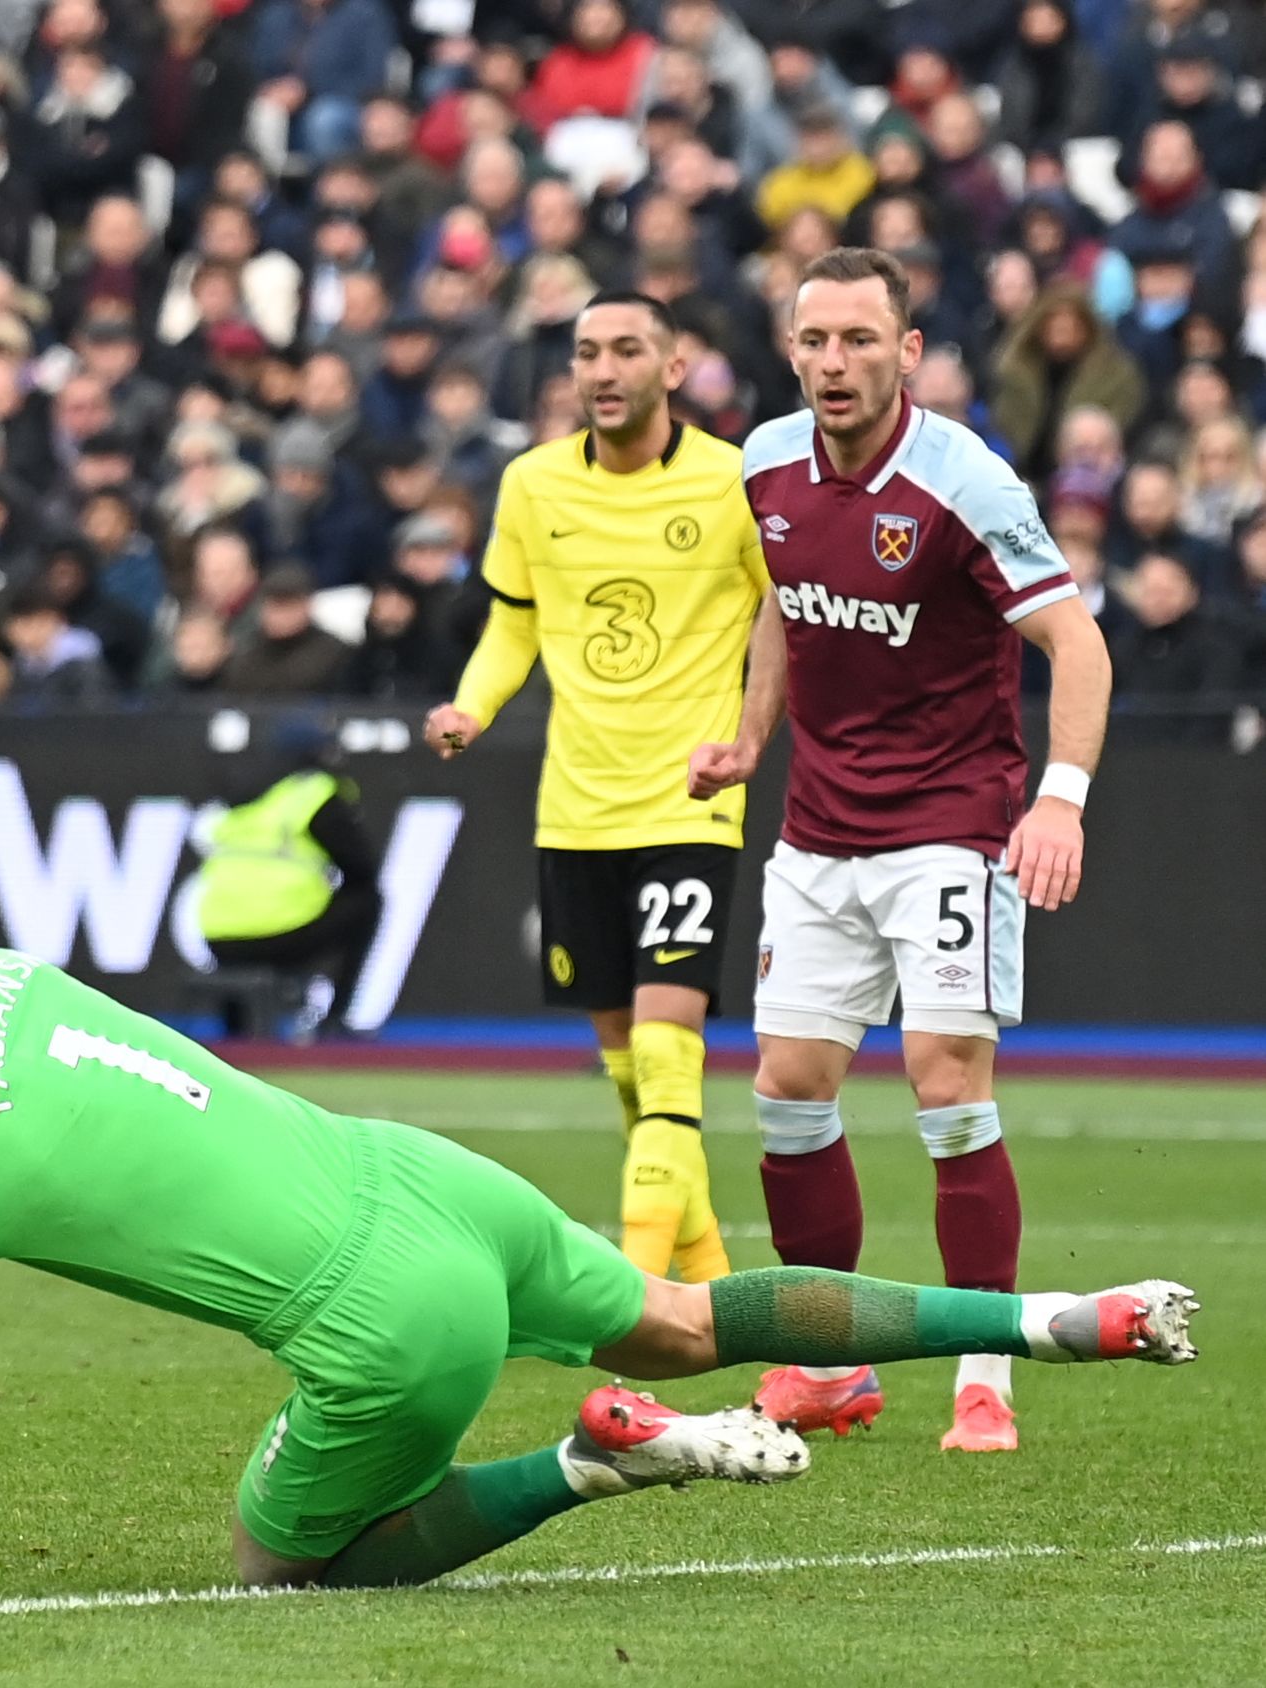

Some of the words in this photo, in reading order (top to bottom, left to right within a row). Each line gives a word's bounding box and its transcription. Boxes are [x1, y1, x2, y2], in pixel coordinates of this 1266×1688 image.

[585, 577, 661, 683] 3
[777, 581, 921, 648] etway
[638, 878, 714, 949] 22
[937, 885, 974, 952] 5
[47, 1024, 212, 1113] 1
